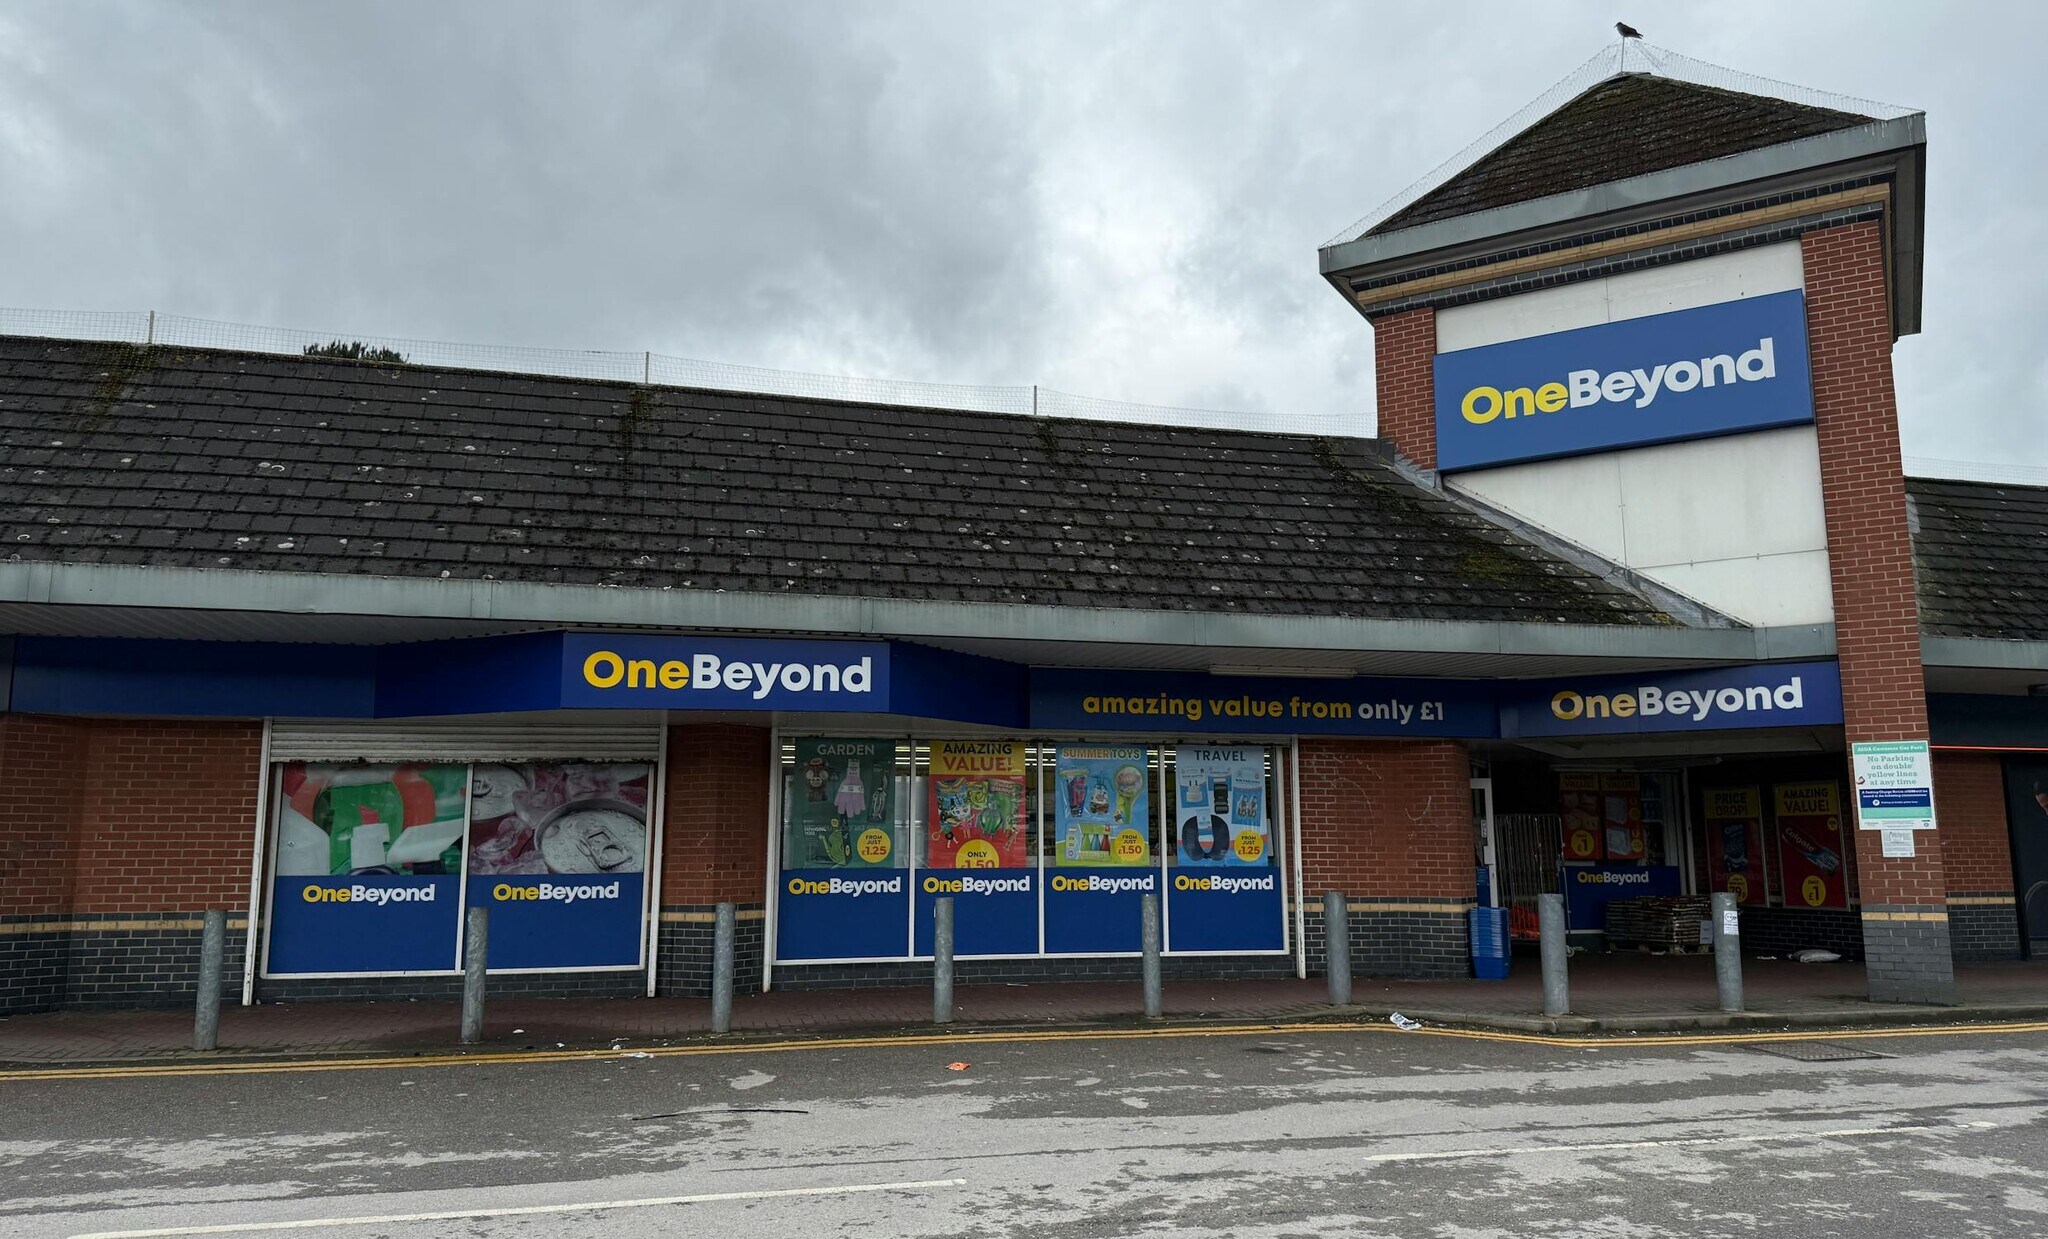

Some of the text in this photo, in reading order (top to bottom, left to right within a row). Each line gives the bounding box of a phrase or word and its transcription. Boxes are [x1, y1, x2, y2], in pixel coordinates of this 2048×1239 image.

[1461, 337, 1777, 425] OneBeyond
[583, 650, 872, 700] OneBeyond
[1550, 676, 1804, 722] OneBeyond
[1082, 692, 1444, 726] amazing value from only £1
[816, 743, 875, 757] GARDEN
[943, 743, 1013, 756] AMAZING
[1063, 748, 1141, 760] SUMMER TOYS
[1194, 750, 1247, 762] TRAVEL
[943, 756, 1013, 772] VALUE!
[1880, 755, 1915, 763] Parking
[1867, 771, 1895, 779] yellow
[1783, 787, 1829, 799] AMAZING
[1783, 799, 1830, 813] VALUE!
[862, 846, 888, 857] £1.25
[966, 851, 988, 859] ONLY
[1118, 844, 1143, 856] £1.50
[1237, 845, 1261, 856] £1.25
[923, 875, 1030, 896] OneBeyond
[1051, 874, 1155, 895] OneBeyond
[1174, 874, 1274, 895] OneBeyond
[1577, 870, 1650, 886] OneBeyond
[492, 880, 620, 905] OneBeyond
[788, 876, 901, 898] OneBeyond
[302, 883, 436, 907] OneBeyond
